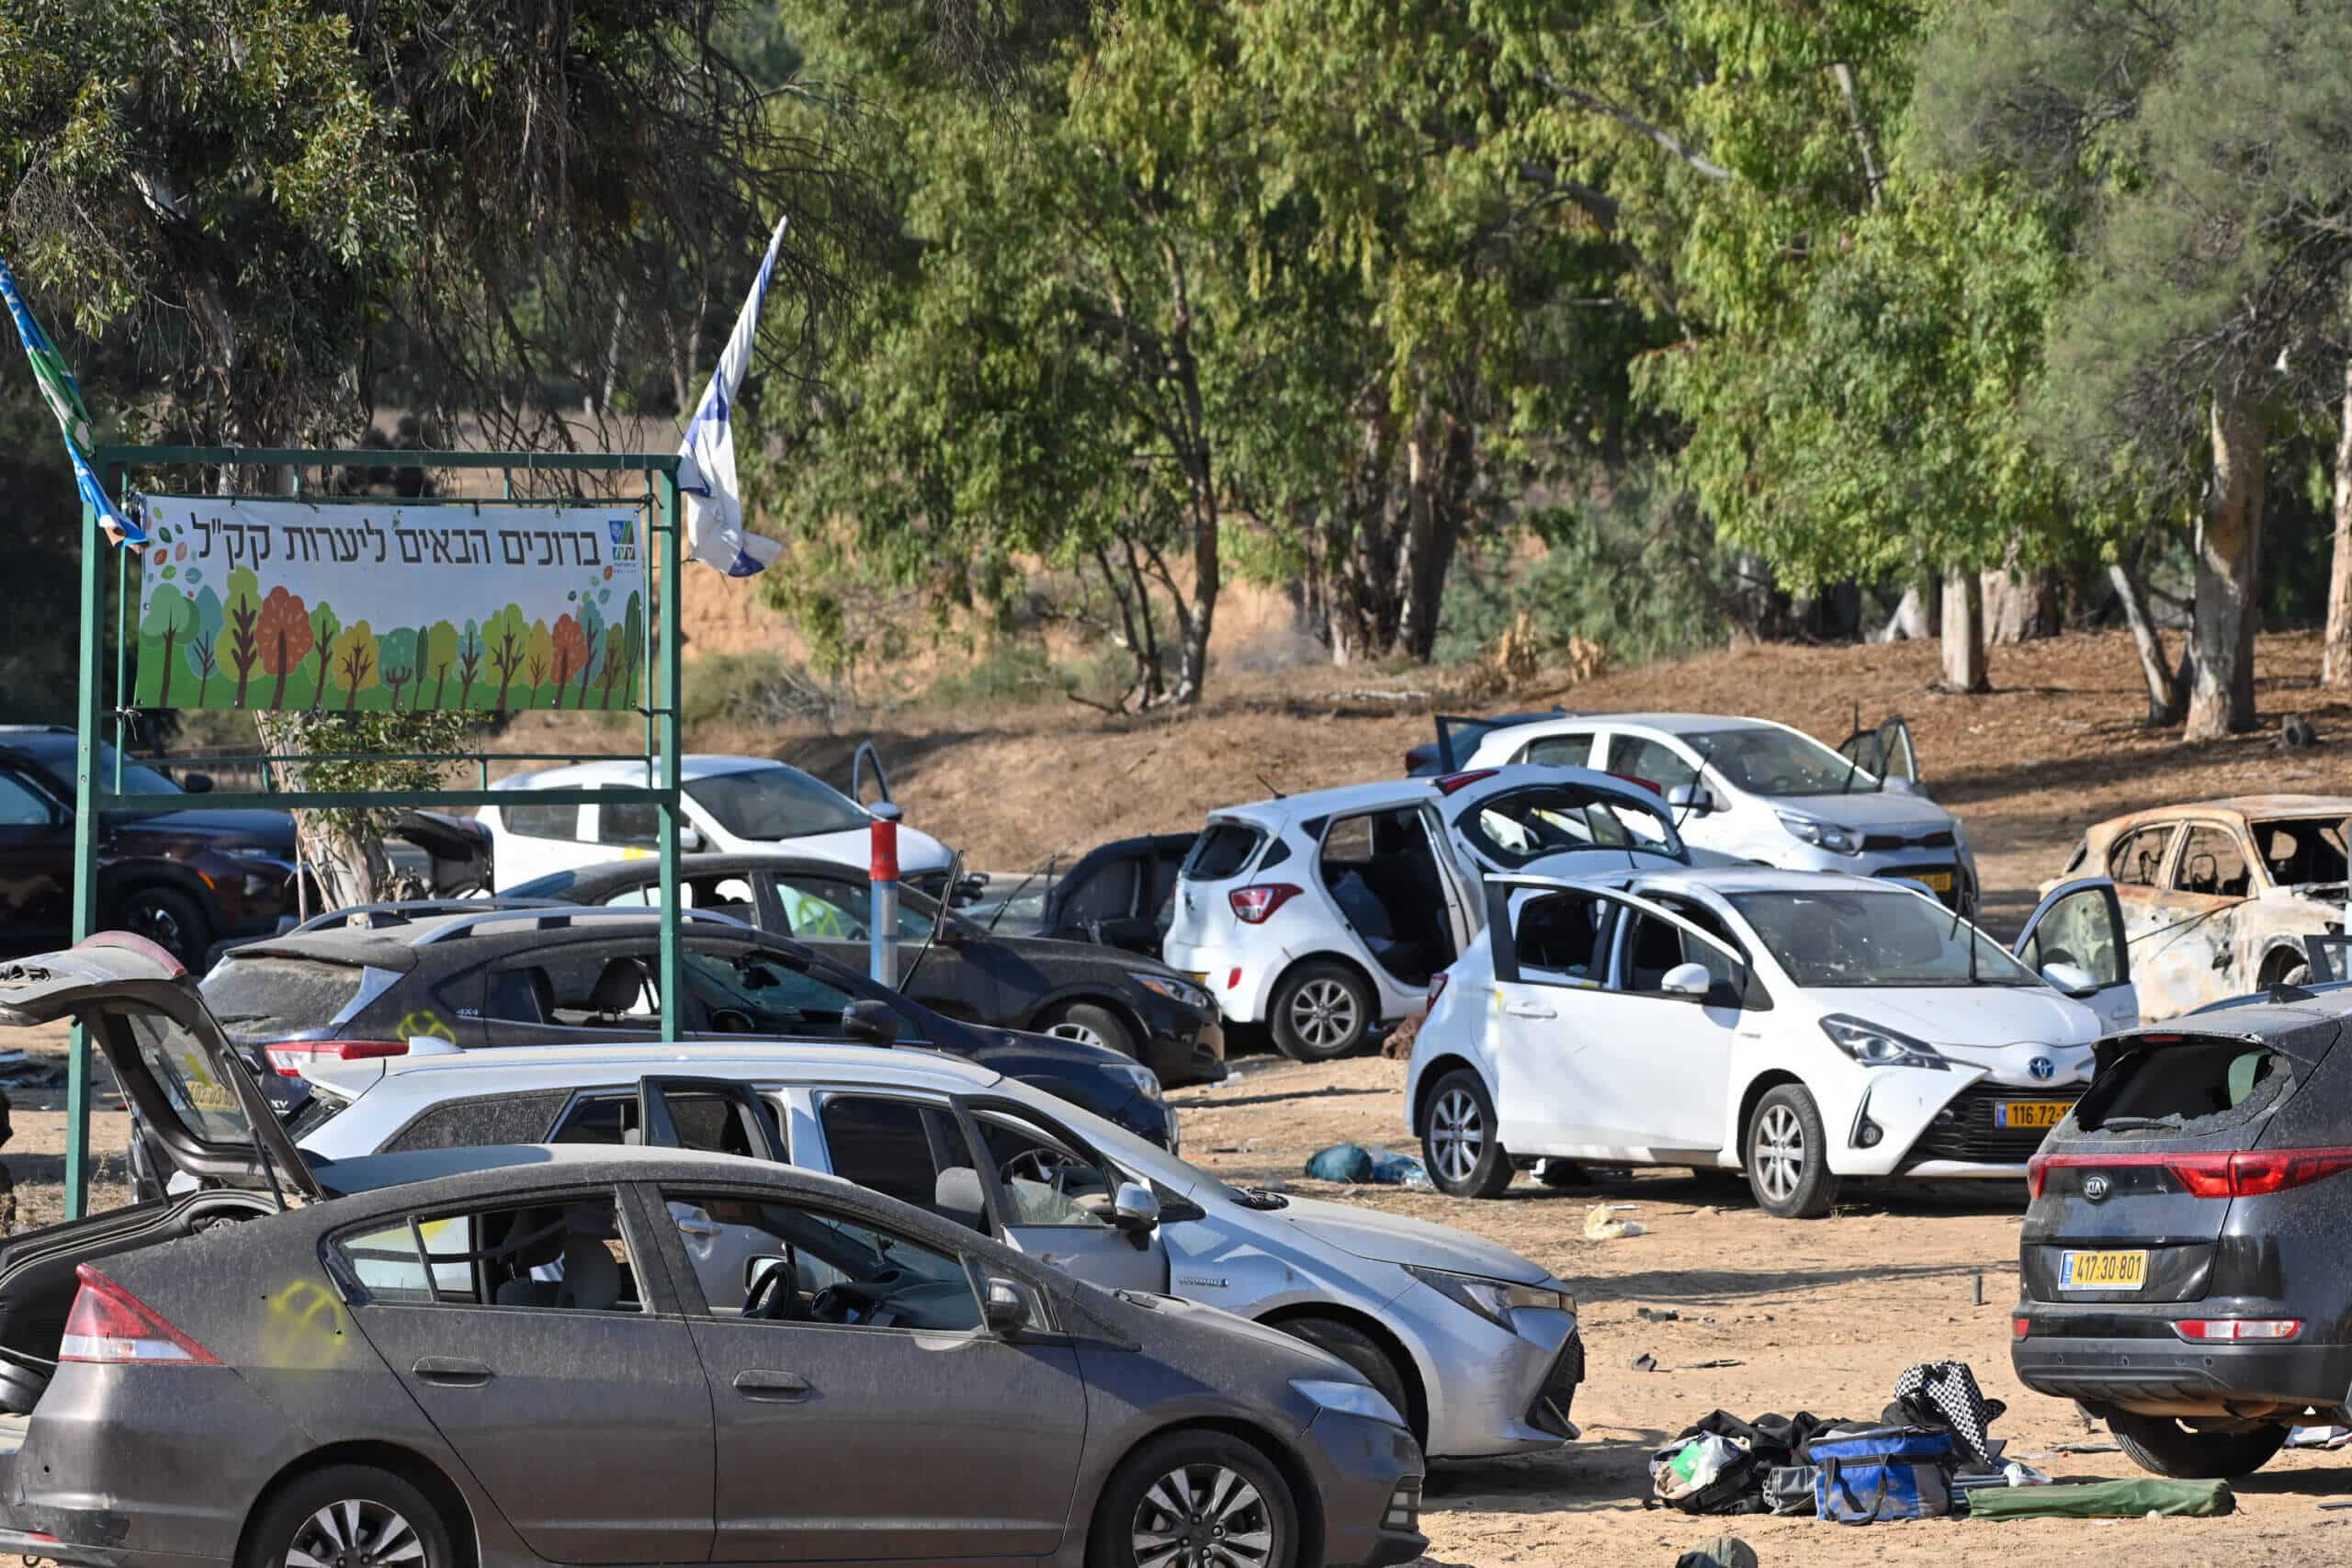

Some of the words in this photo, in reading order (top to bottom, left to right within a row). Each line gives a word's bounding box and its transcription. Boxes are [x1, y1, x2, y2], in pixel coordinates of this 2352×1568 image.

[190, 512, 270, 570] קק"ל
[282, 518, 386, 562] ליערות
[394, 528, 492, 564] הבאים
[498, 530, 602, 566] ברוכים
